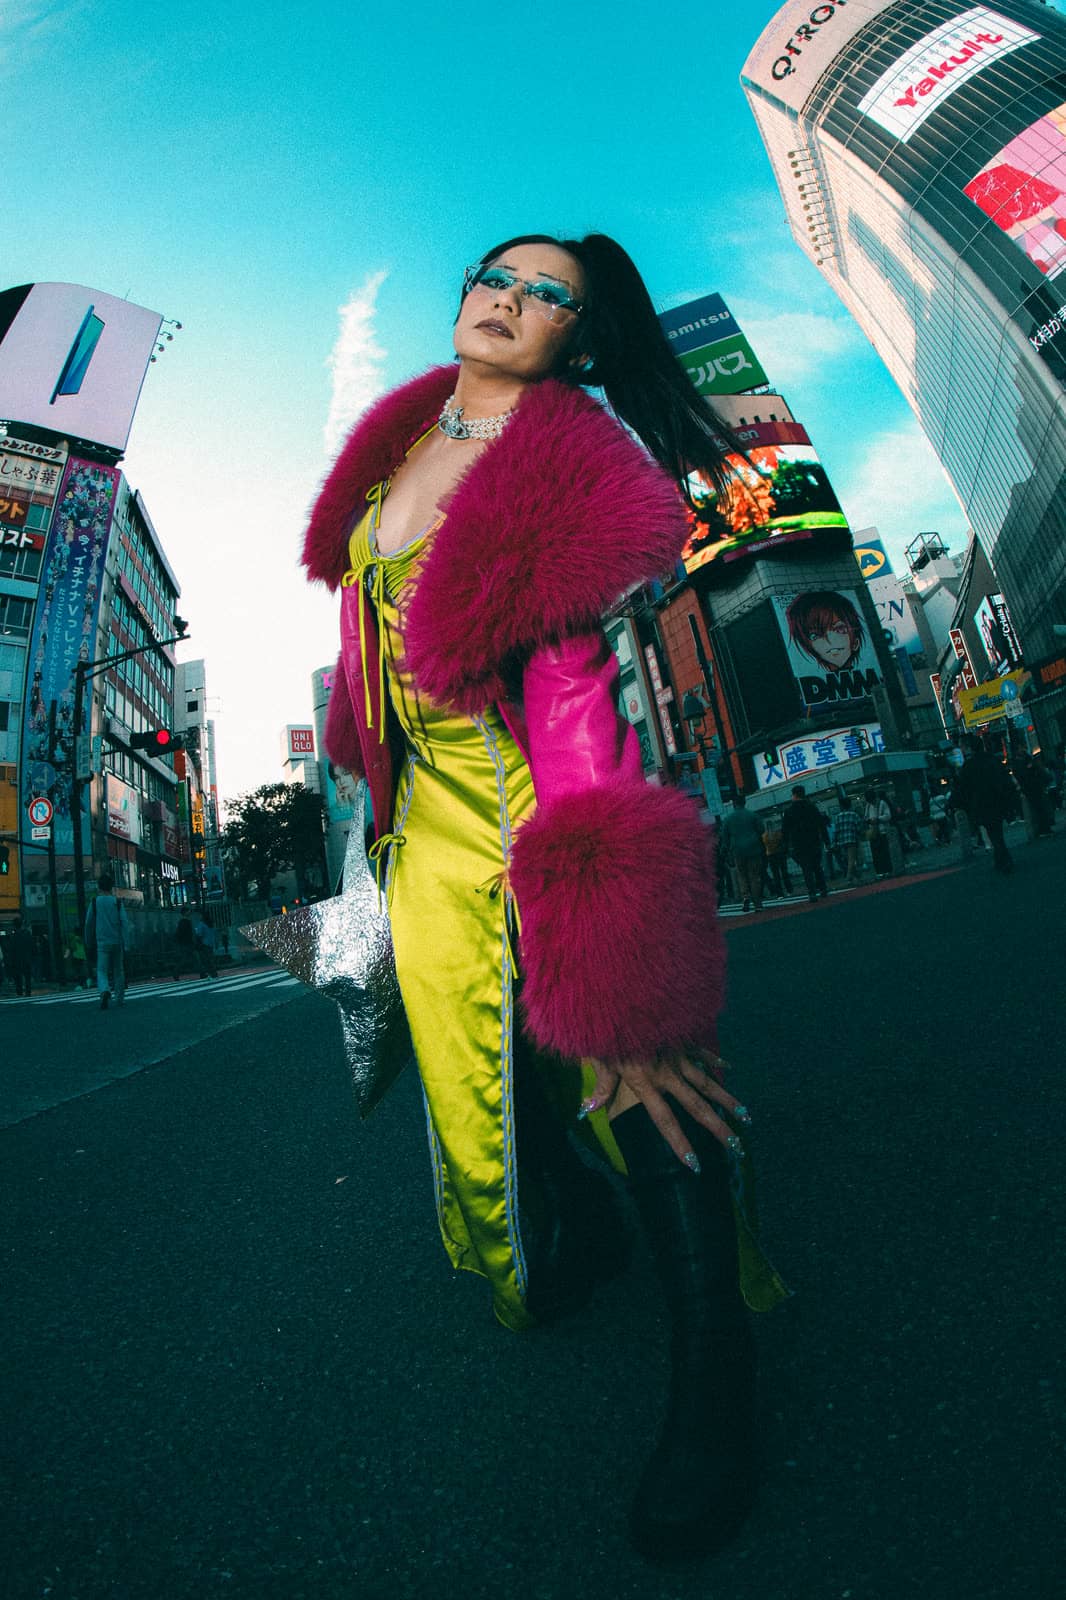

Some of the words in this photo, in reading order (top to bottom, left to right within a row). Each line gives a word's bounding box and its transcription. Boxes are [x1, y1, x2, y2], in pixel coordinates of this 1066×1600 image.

[893, 33, 1003, 108] Yakult
[1, 459, 57, 486] しゃぶ葉
[797, 667, 882, 706] DMM
[293, 732, 309, 741] UNI
[294, 742, 311, 751] QLO
[160, 860, 179, 881] LUSH
